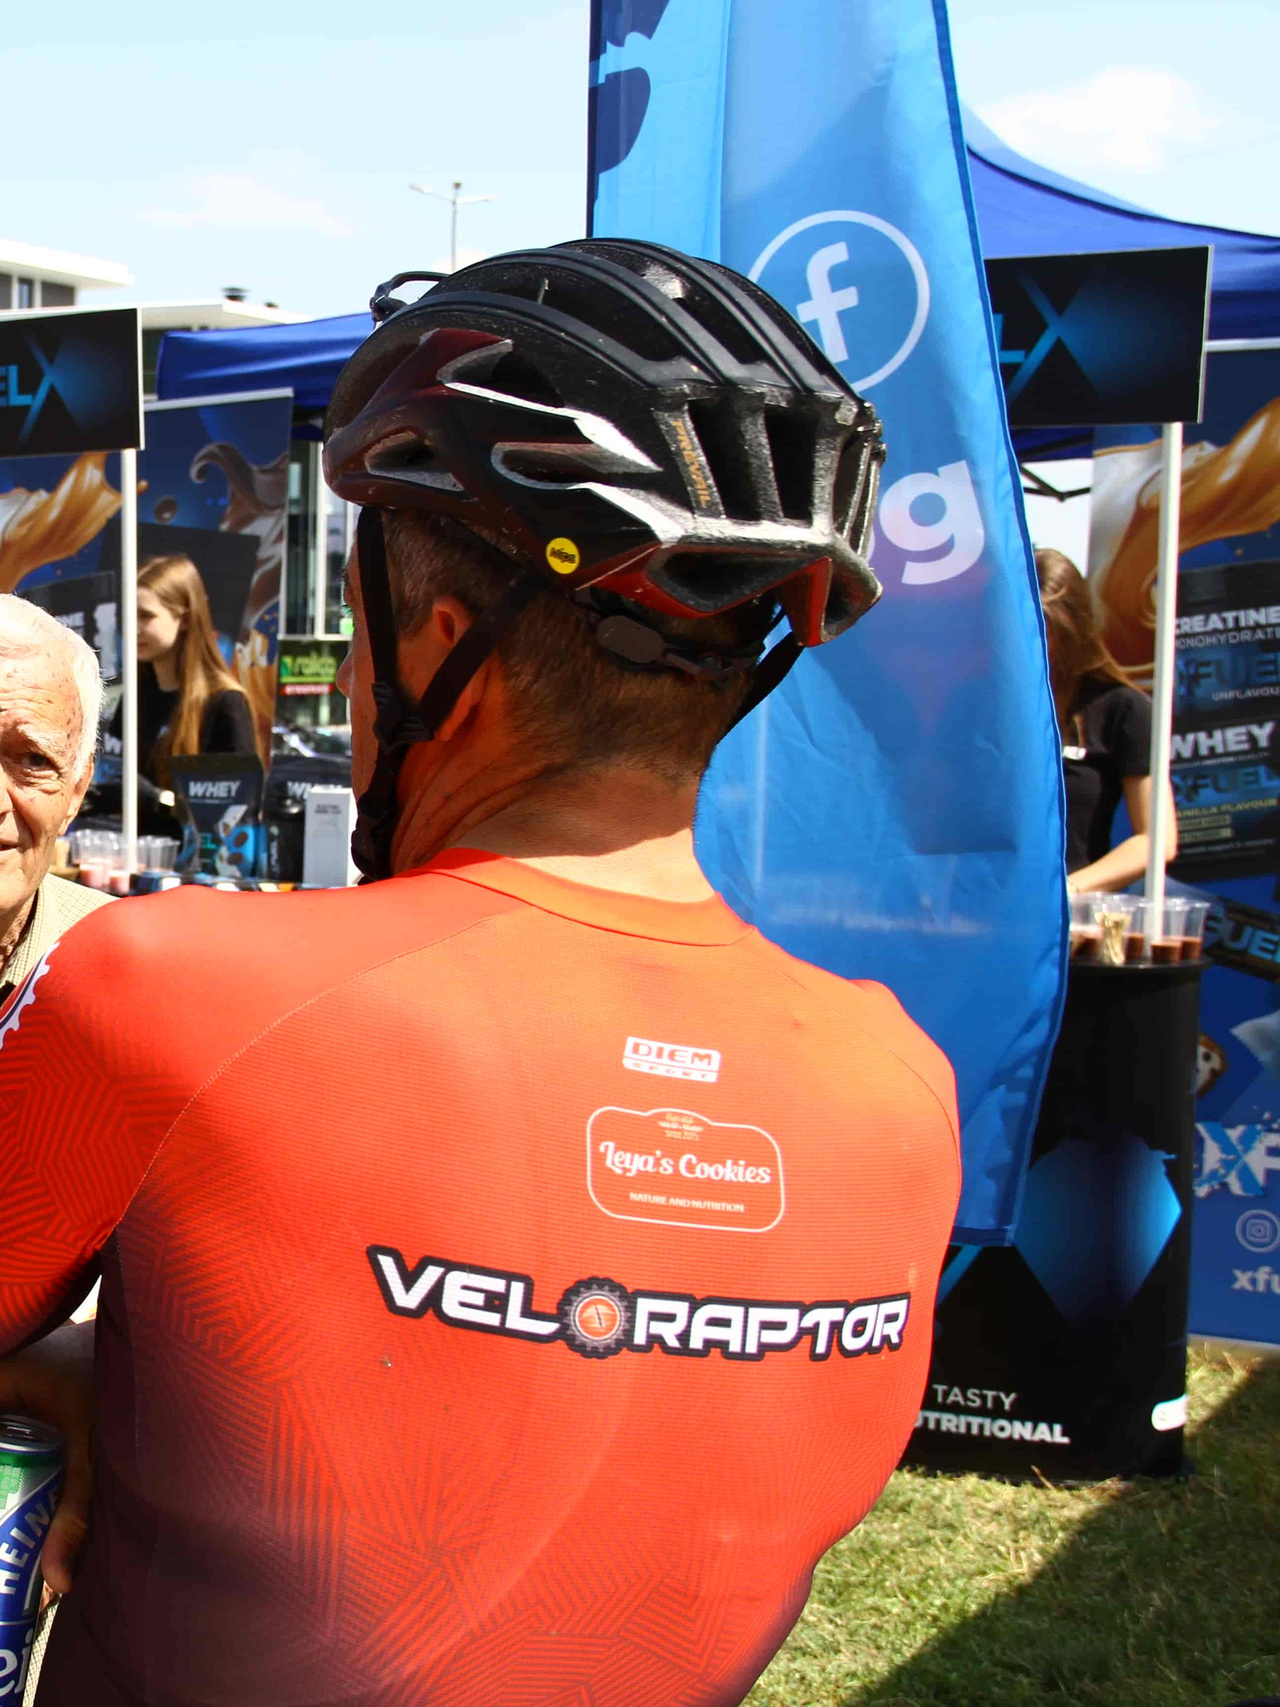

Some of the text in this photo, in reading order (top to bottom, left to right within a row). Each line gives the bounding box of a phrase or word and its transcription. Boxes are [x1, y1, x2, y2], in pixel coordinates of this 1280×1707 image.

[671, 418, 712, 509] PREVAIL
[1176, 627, 1280, 650] ONOHYDRATE
[188, 780, 242, 798] WHEY
[1178, 804, 1219, 818] ANILLA
[631, 1041, 713, 1067] DIEM
[599, 1141, 772, 1184] Leya's Cookies
[629, 1192, 745, 1213] NATURE AND NUTRITION
[932, 1383, 1018, 1412] TASTY
